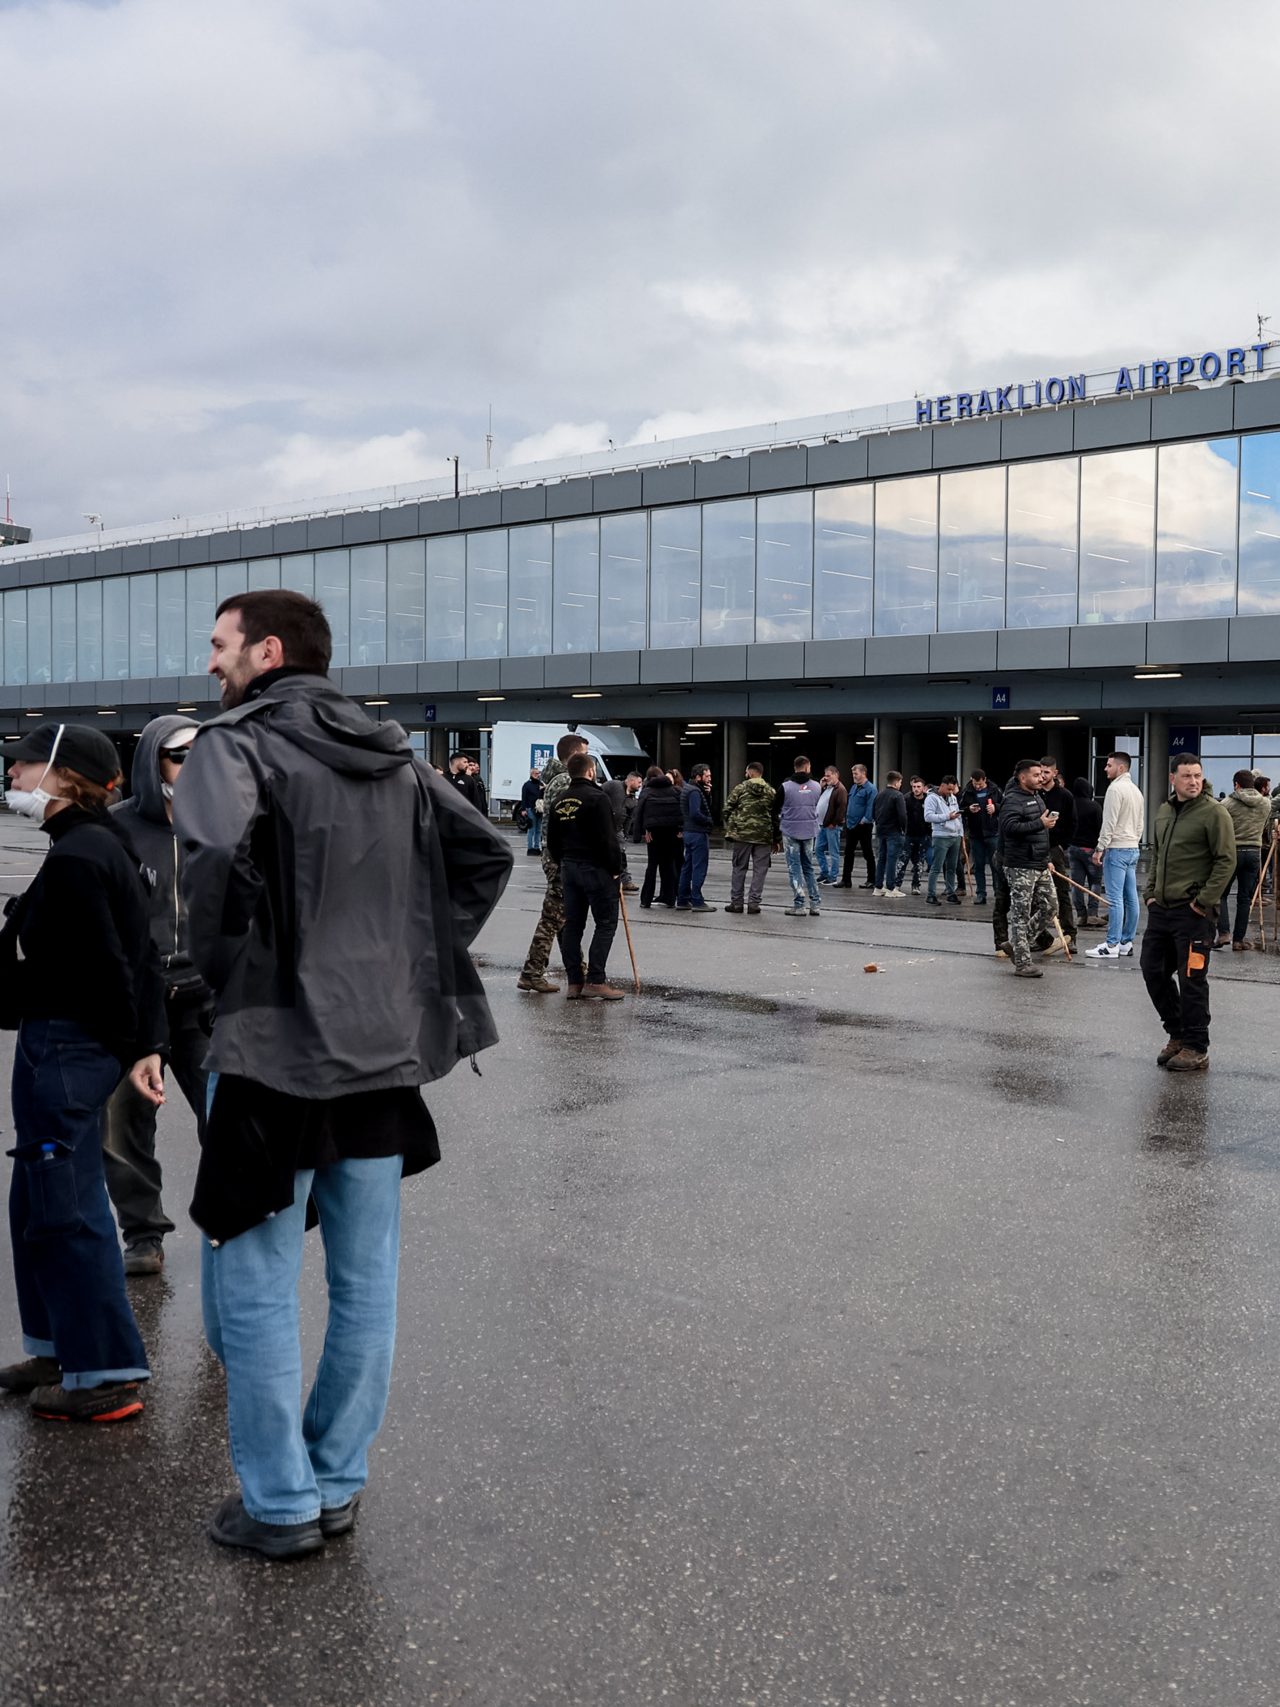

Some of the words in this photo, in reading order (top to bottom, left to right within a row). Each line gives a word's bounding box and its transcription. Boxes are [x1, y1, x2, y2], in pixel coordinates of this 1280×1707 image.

[916, 374, 1086, 425] HERAKLION
[1115, 343, 1268, 394] AIRPORT
[996, 692, 1006, 703] A4
[1173, 736, 1185, 746] A4
